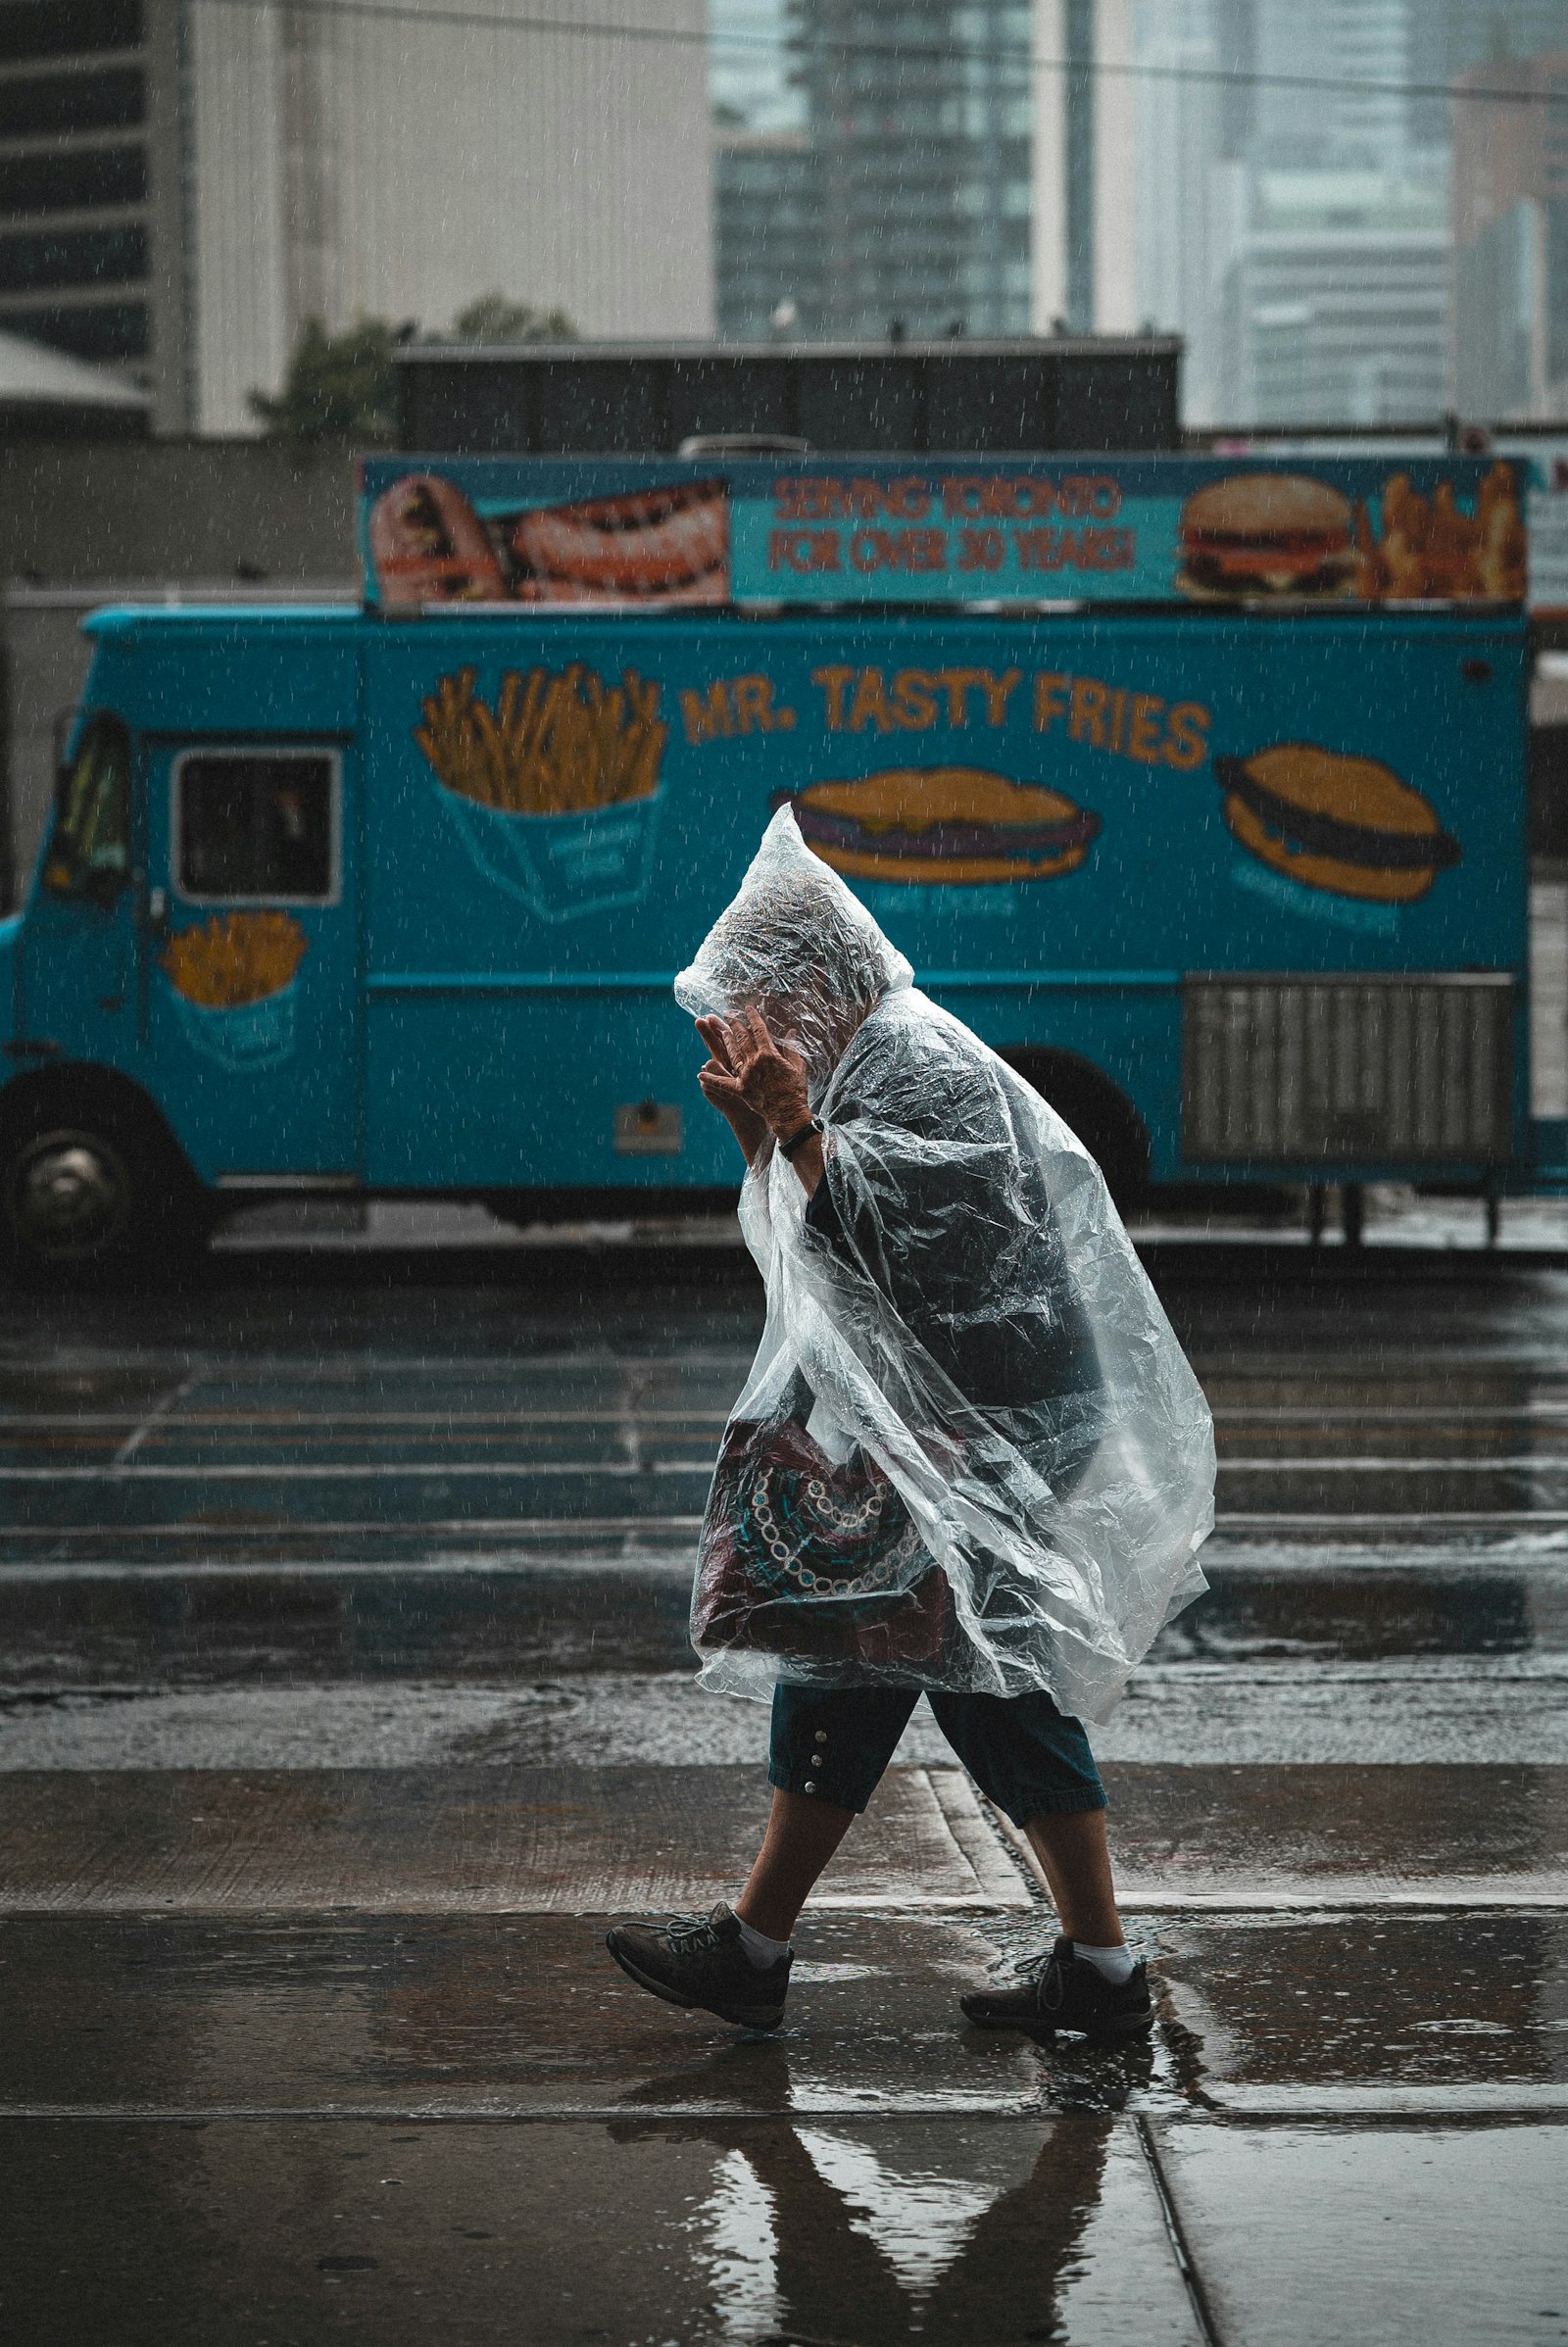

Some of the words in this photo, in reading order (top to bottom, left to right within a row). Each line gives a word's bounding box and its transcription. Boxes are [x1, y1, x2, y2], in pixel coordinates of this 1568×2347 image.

[774, 478, 930, 518] SERVING
[943, 477, 1120, 518] TORONTO
[770, 530, 840, 569] FOR
[852, 530, 946, 569] OVER
[959, 530, 1004, 569] 30
[680, 676, 796, 744] MR.
[813, 667, 1021, 732] TASTY
[1036, 674, 1209, 769] FRIES
